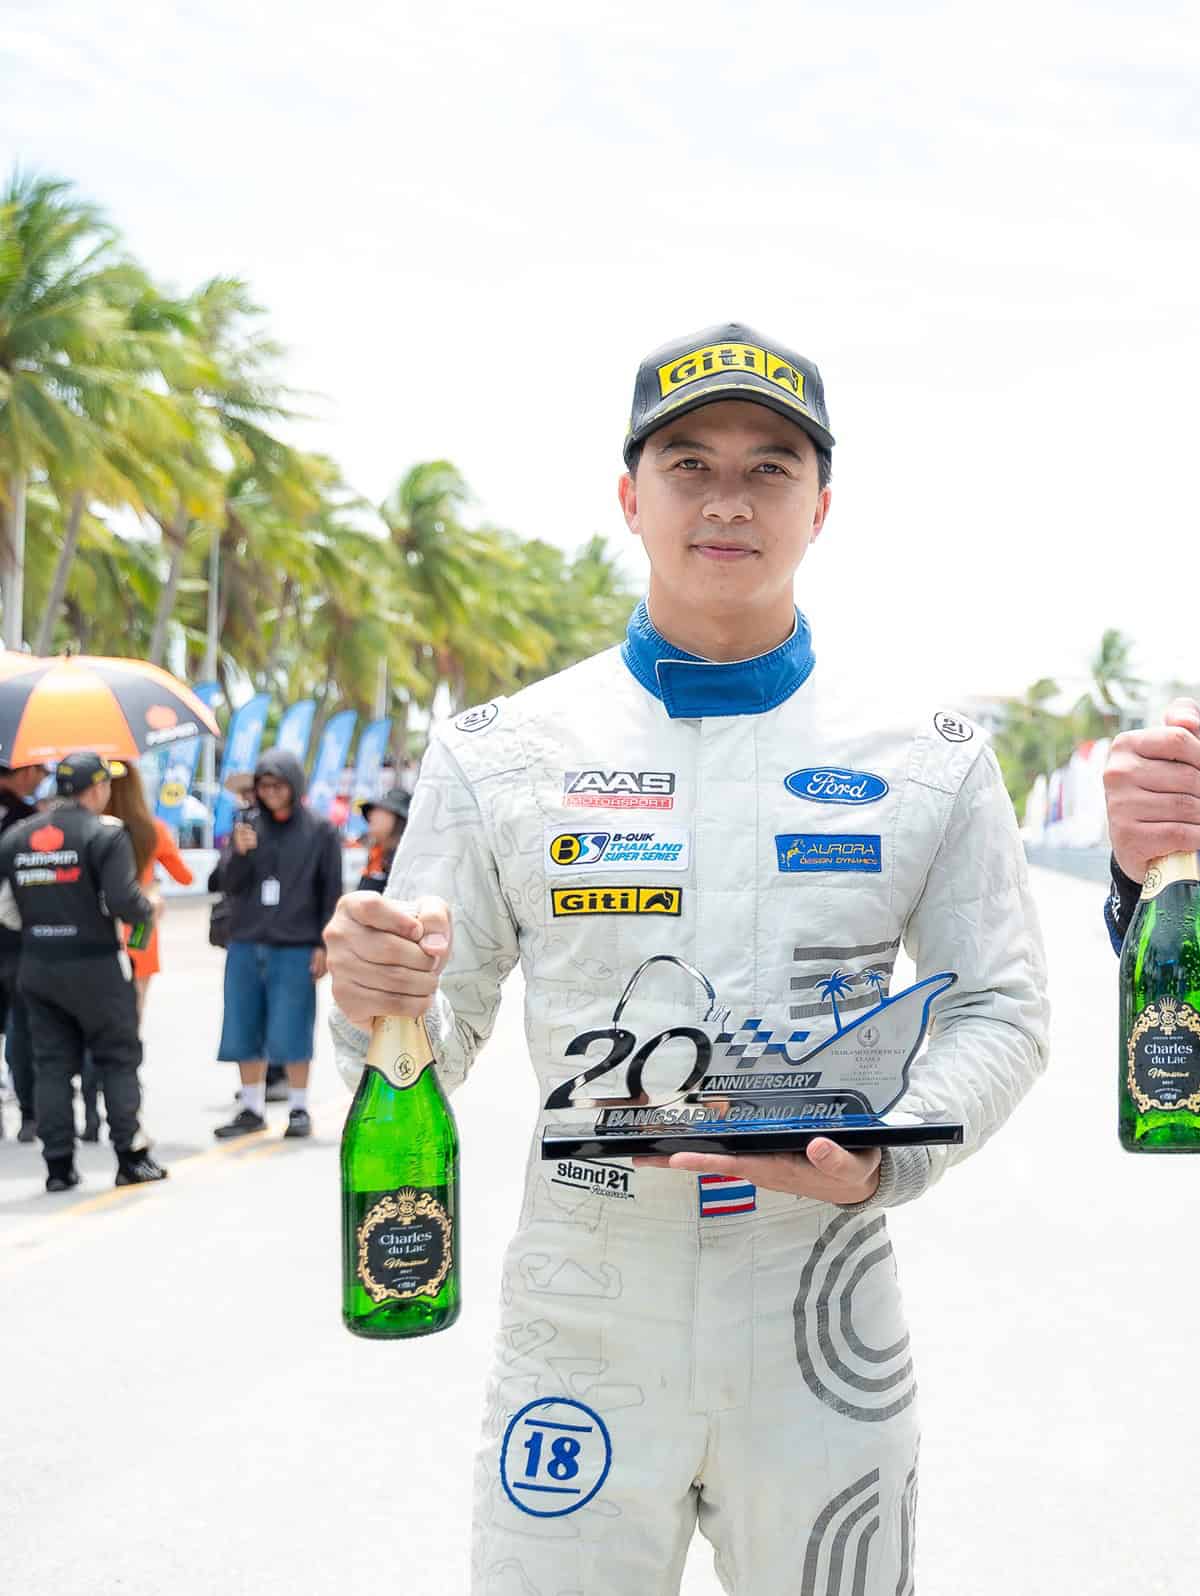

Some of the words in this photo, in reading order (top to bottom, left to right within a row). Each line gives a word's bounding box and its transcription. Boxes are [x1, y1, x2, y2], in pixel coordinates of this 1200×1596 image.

[670, 349, 756, 384] Giti
[568, 771, 675, 794] AAS
[807, 771, 868, 798] Ford
[613, 832, 655, 841] B-QUIK
[609, 842, 683, 852] THAILAND
[806, 843, 875, 855] AURORA
[603, 852, 639, 861] SUPER
[640, 852, 679, 861] SERIES
[560, 892, 629, 910] Giti
[1144, 1043, 1192, 1054] Charles
[1152, 1056, 1164, 1064] du
[704, 1074, 816, 1090] ANNIVERSARY
[606, 1107, 721, 1126] BANGSAEN
[726, 1104, 795, 1121] GRAND
[801, 1102, 848, 1120] PRIX
[557, 1161, 628, 1192] stand21
[380, 1232, 432, 1244] Charles
[388, 1246, 402, 1254] du
[524, 1431, 581, 1481] 18
